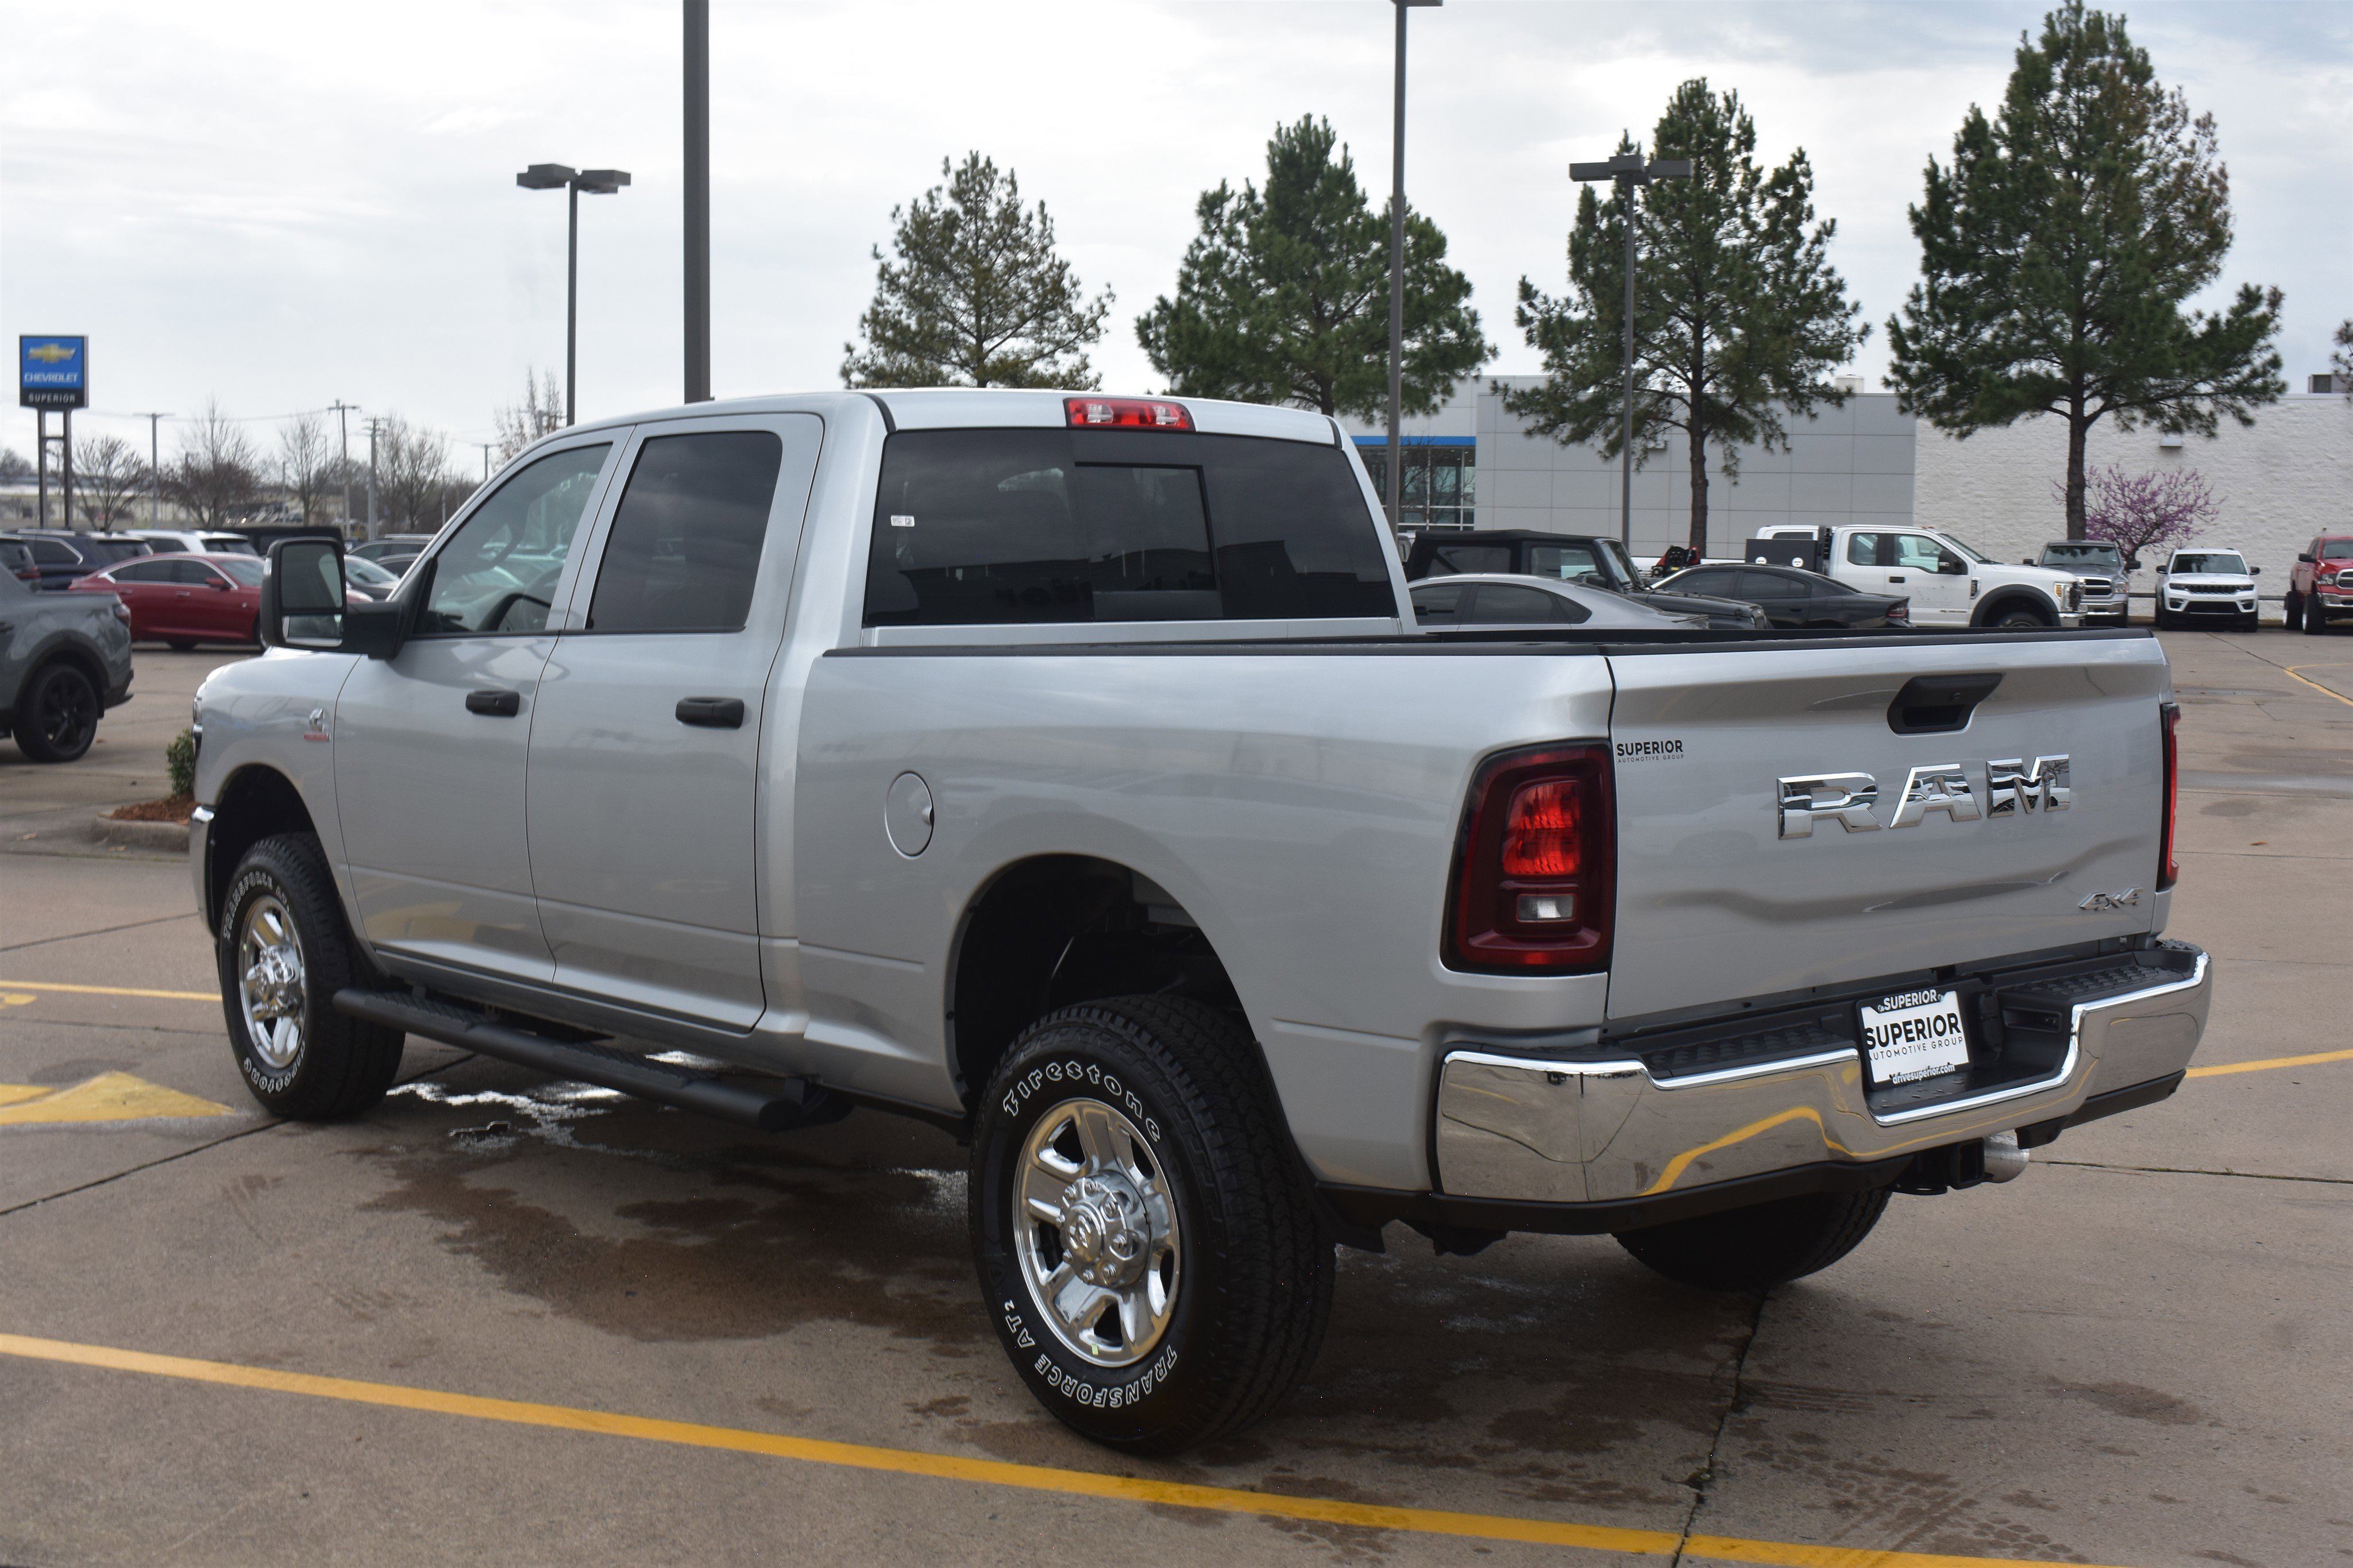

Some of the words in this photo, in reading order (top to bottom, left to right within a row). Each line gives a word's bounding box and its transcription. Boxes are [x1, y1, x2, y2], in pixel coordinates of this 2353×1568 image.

[24, 372, 78, 383] CHEVROLET
[29, 393, 75, 403] SUPERIOR
[1617, 740, 1683, 756] SUPERIOR
[1776, 754, 2069, 840] RAM
[223, 871, 273, 940] TRANSFORCE
[1883, 989, 1937, 1011] SUPERIOR
[1865, 1012, 1961, 1050] SUPERIOR
[1931, 1036, 1964, 1049] GROUP
[1892, 1064, 1955, 1084] drivesuperior.com
[1003, 1060, 1160, 1142] Firestone
[1034, 1345, 1178, 1408] TRANSFORCE
